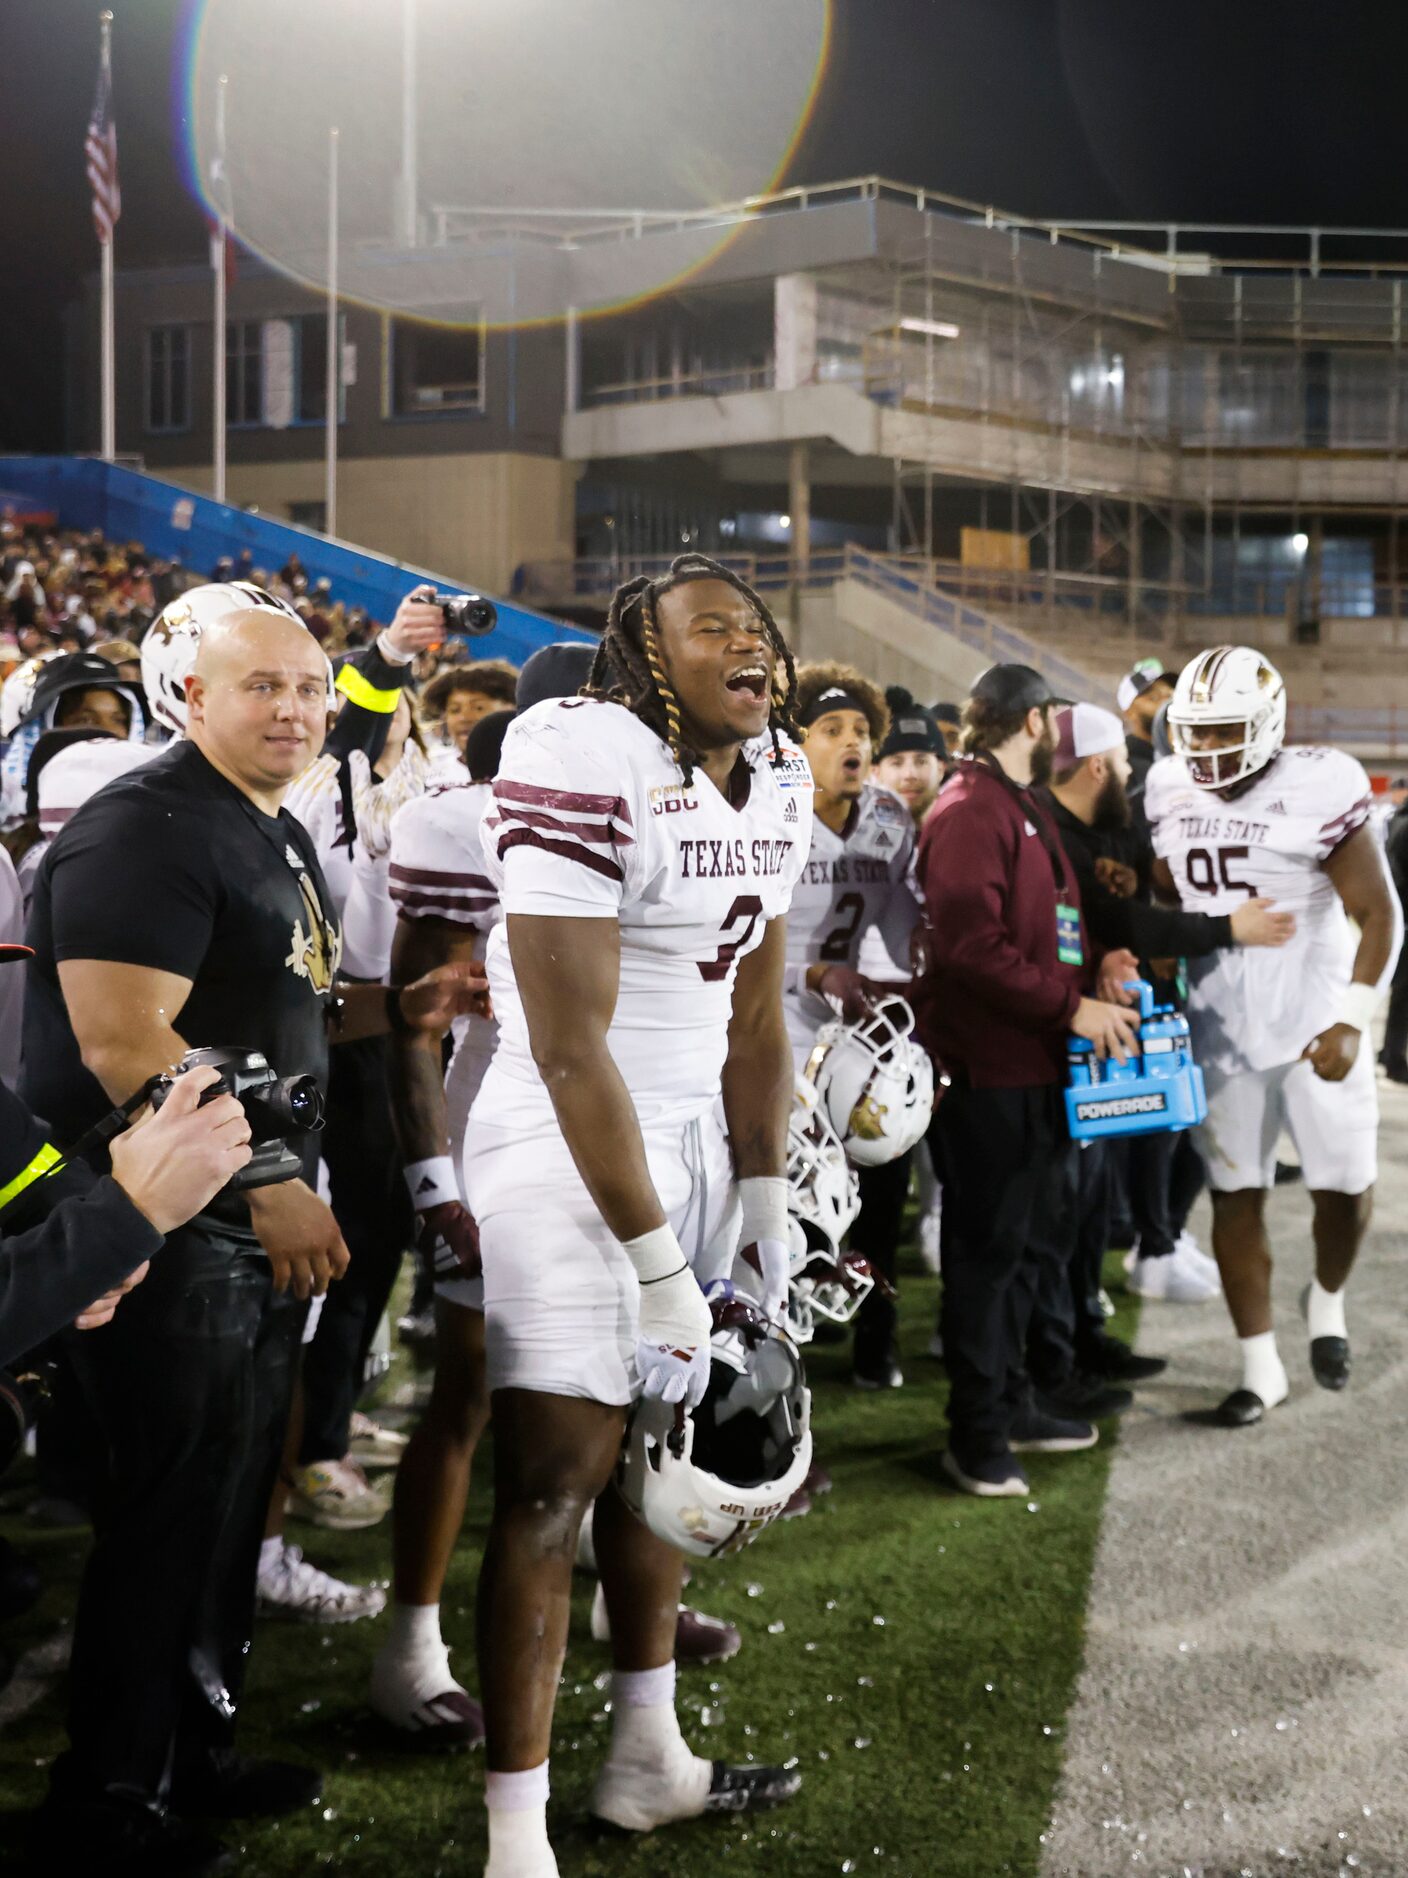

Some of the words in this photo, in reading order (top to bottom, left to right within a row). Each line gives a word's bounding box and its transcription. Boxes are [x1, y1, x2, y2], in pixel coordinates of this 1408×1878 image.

[1179, 817, 1220, 839] TEXAS
[1223, 819, 1270, 844] STATE
[680, 840, 746, 878] TEXAS
[751, 839, 794, 876] STATE
[1186, 846, 1258, 898] 95
[819, 892, 865, 960] 2
[1077, 1094, 1165, 1121] POWERADE
